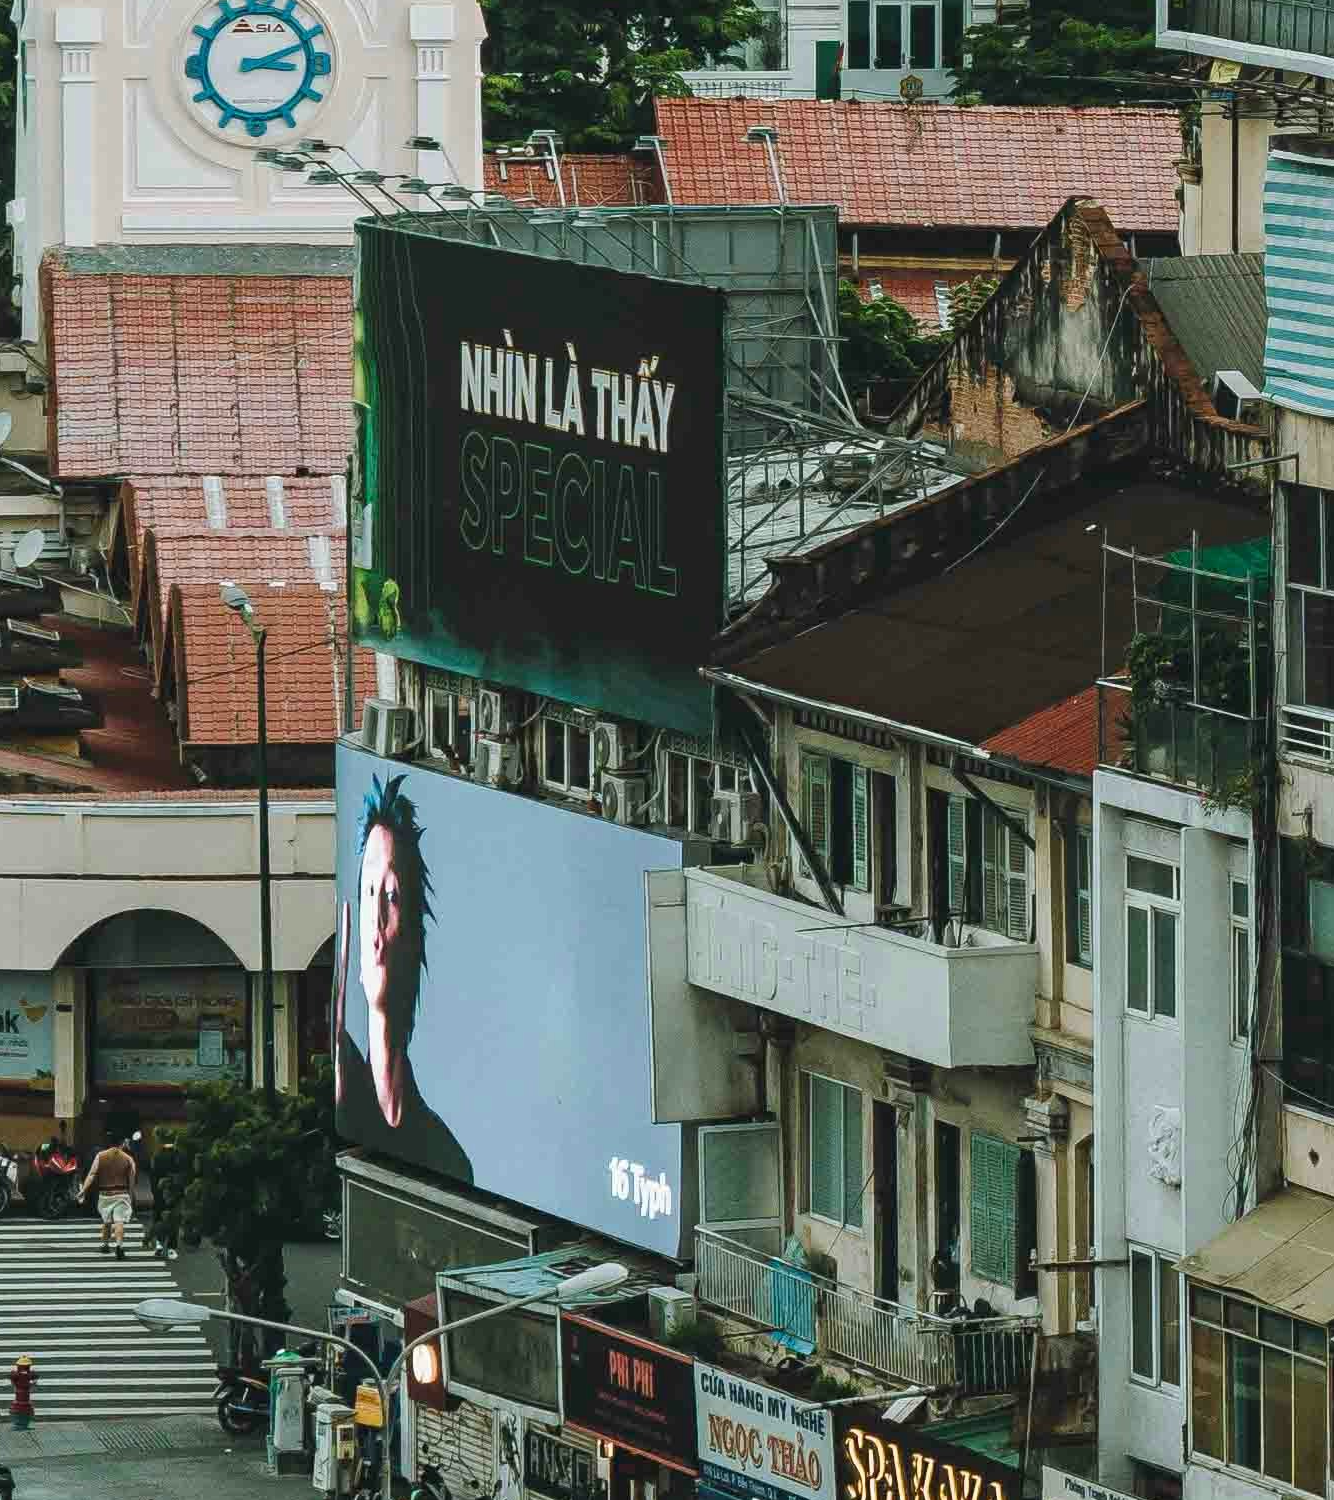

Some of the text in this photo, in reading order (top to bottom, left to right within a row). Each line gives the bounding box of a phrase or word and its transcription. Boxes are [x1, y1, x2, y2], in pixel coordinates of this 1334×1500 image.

[460, 328, 676, 454] NHÌN LÀ THẤY
[459, 430, 678, 598] SPECIAL
[708, 1412, 764, 1472] NGỌC
